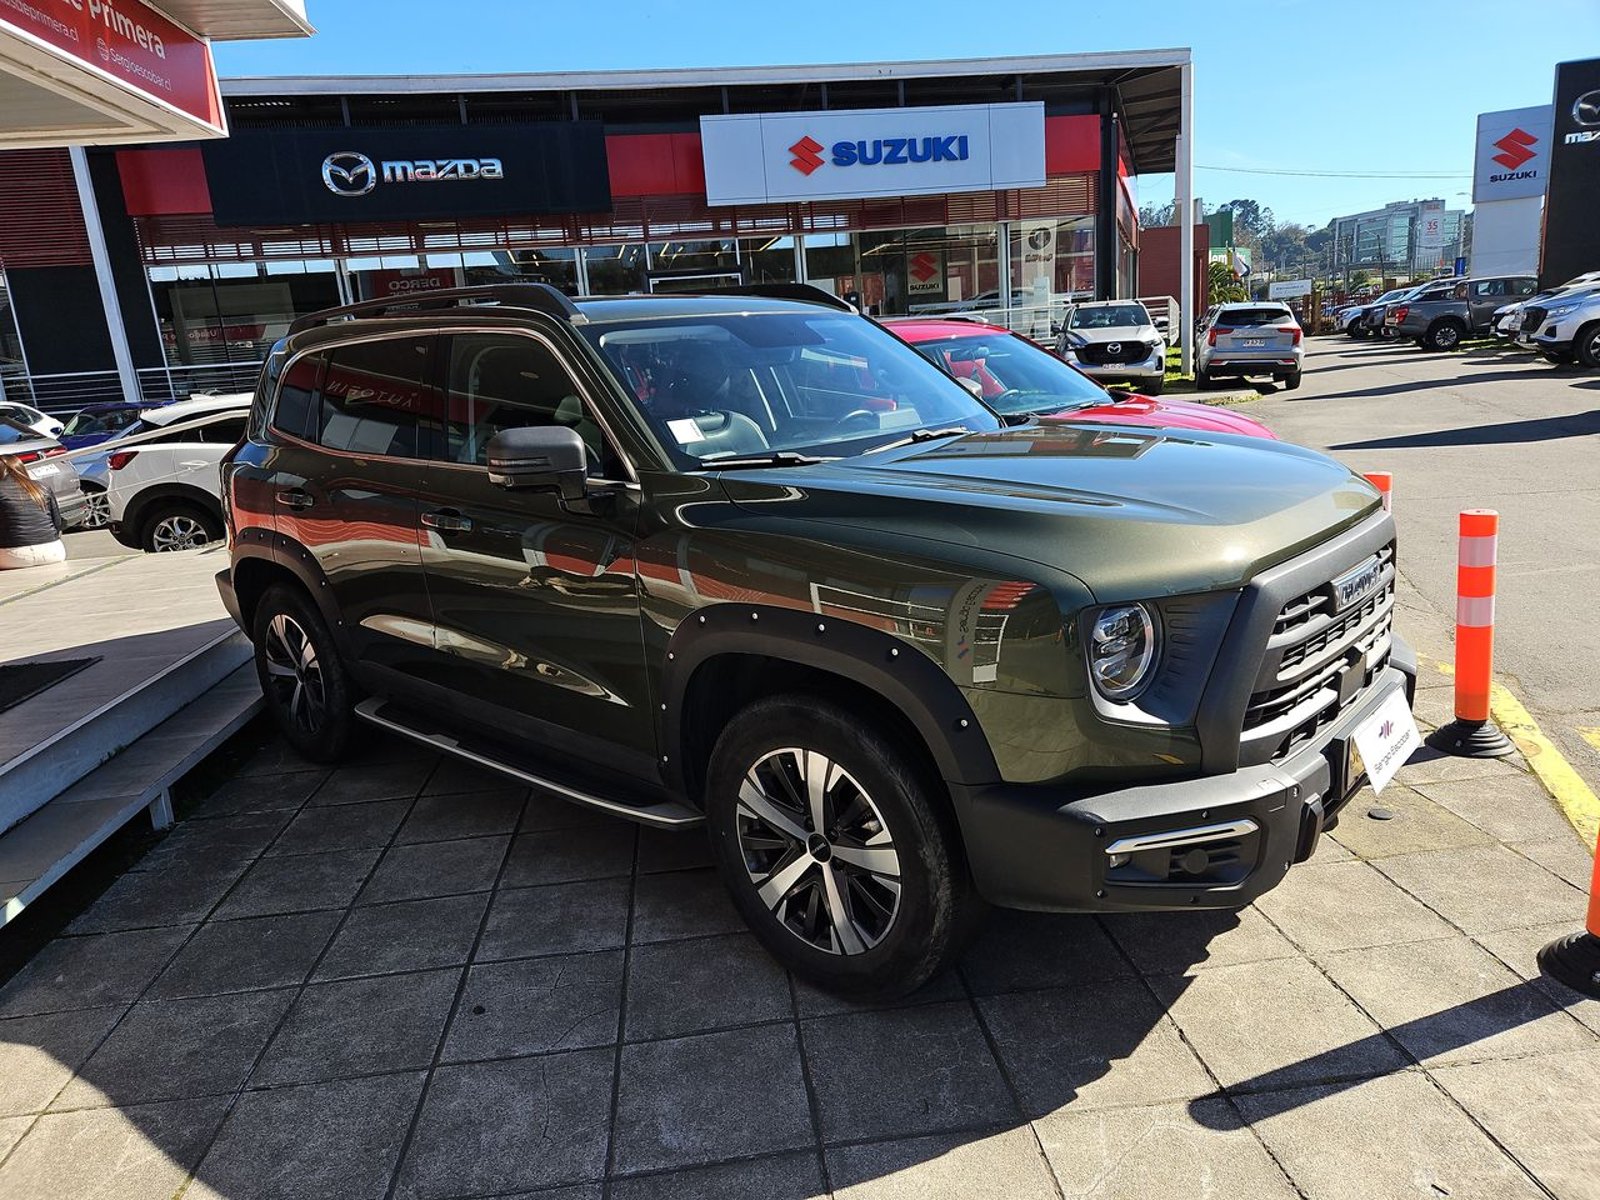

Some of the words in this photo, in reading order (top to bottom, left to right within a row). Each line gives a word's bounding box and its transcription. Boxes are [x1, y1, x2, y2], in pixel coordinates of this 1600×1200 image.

[831, 135, 969, 167] SUZUKI
[381, 157, 504, 183] mazda
[1490, 171, 1537, 183] SUZUKI
[909, 283, 940, 291] SUZUKI
